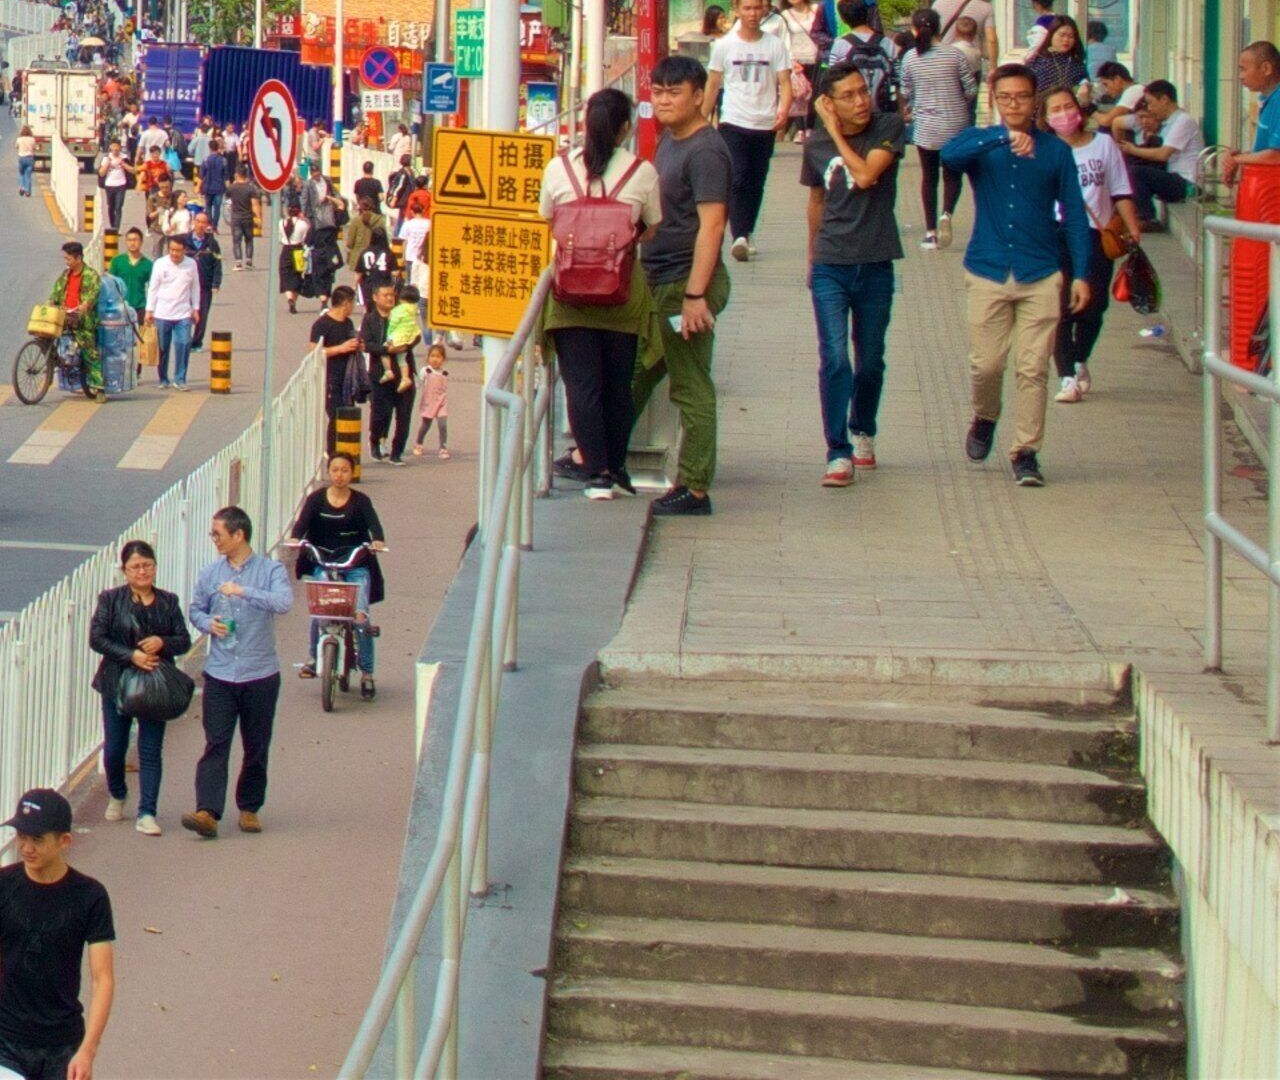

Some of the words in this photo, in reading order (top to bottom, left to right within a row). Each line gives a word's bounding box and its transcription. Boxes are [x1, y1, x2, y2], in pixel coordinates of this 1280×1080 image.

[498, 141, 544, 170] 拍摄
[497, 176, 541, 203] 路段
[461, 223, 543, 251] 本路段禁止停放
[363, 251, 387, 271] 04
